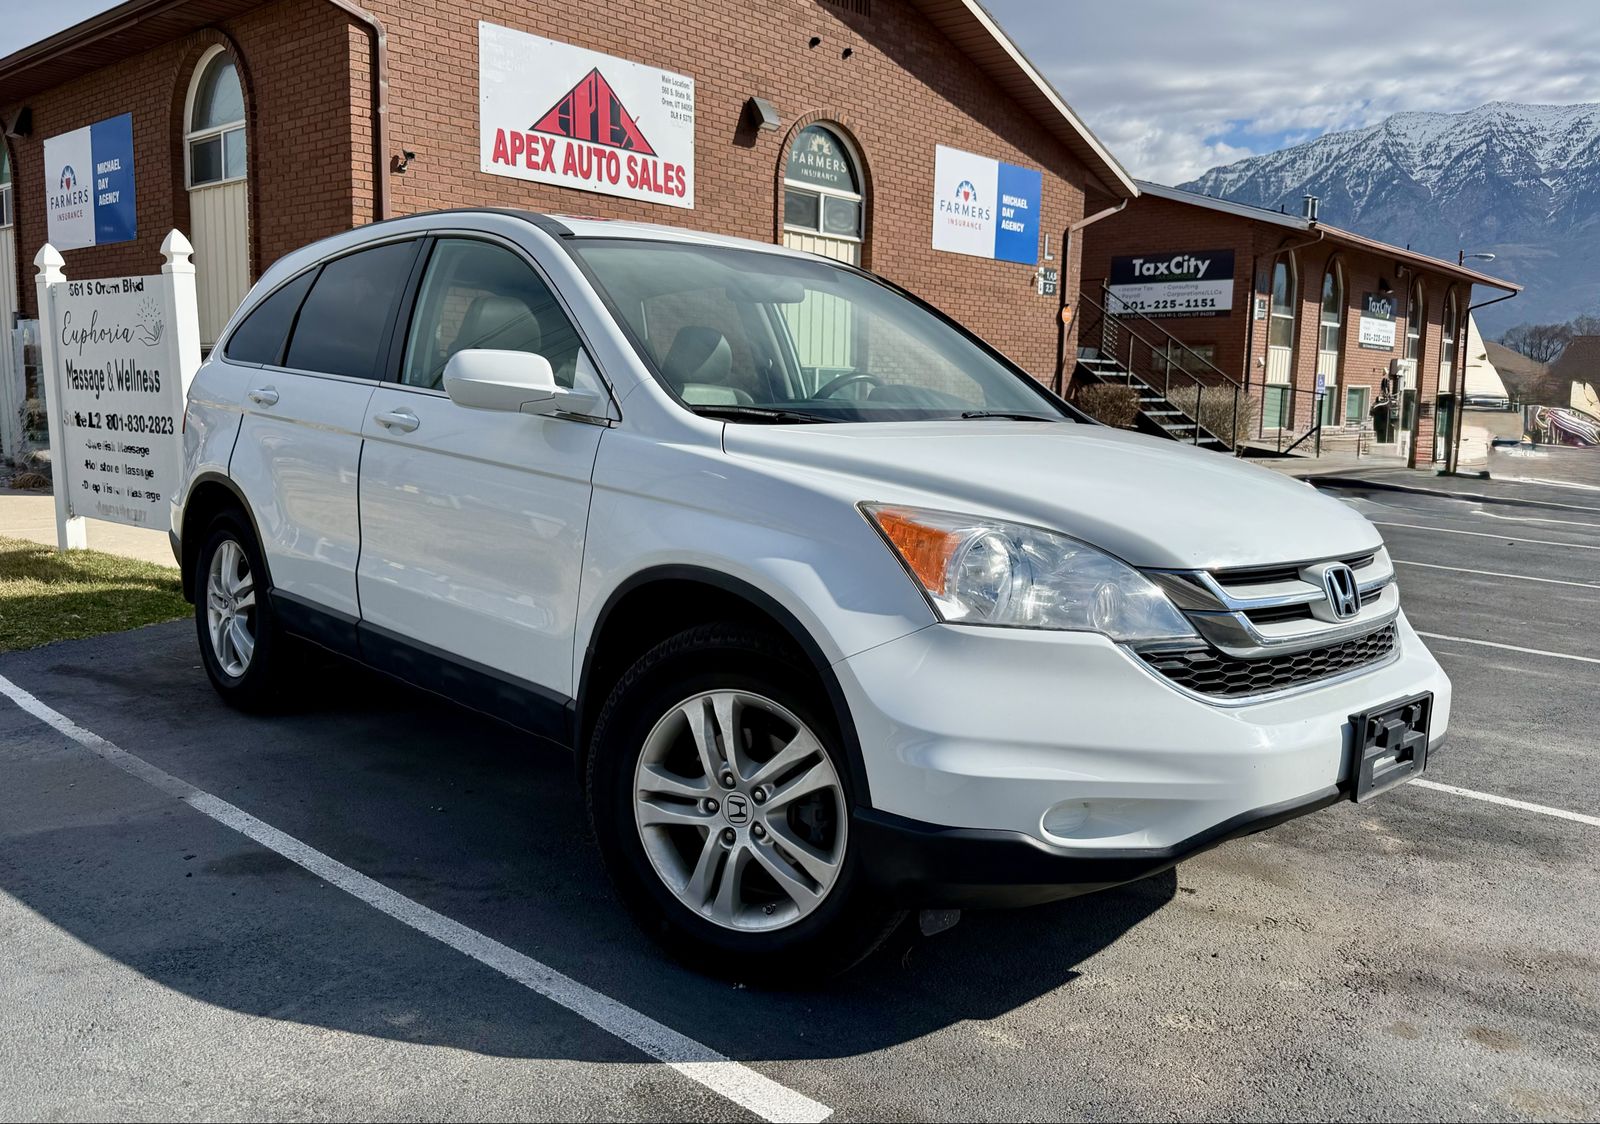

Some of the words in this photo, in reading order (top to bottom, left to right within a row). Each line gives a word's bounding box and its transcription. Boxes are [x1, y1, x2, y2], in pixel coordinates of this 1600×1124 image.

[96, 158, 121, 175] MICHAEL
[492, 128, 556, 173] APEX
[562, 141, 621, 185] AUTO
[626, 154, 686, 198] SALES
[792, 151, 847, 173] FARMERS
[801, 168, 838, 182] INSURANCE
[97, 178, 109, 190] DAY
[50, 189, 89, 210] FARMERS
[98, 191, 120, 206] AGENCY
[1002, 194, 1028, 209] MICHAEL
[56, 209, 83, 222] INSURANCE
[939, 199, 991, 221] FARMERS
[1001, 208, 1015, 219] DAY
[947, 217, 982, 231] INSURANCE
[1001, 220, 1025, 233] AGENCY
[1044, 233, 1054, 260] L
[1132, 255, 1211, 278] TaxCity
[69, 282, 84, 296] 561
[87, 282, 93, 295] S
[123, 278, 144, 293] Blvd
[1122, 298, 1216, 311] 801-225-1151
[1368, 296, 1391, 319] TaxCity
[62, 309, 135, 356] Euphoria
[65, 359, 105, 400] Massage
[106, 361, 115, 392] &
[115, 358, 160, 393] Wellness
[88, 412, 102, 429] L2
[105, 413, 174, 435] 801-830-2823
[127, 486, 161, 502] asage
